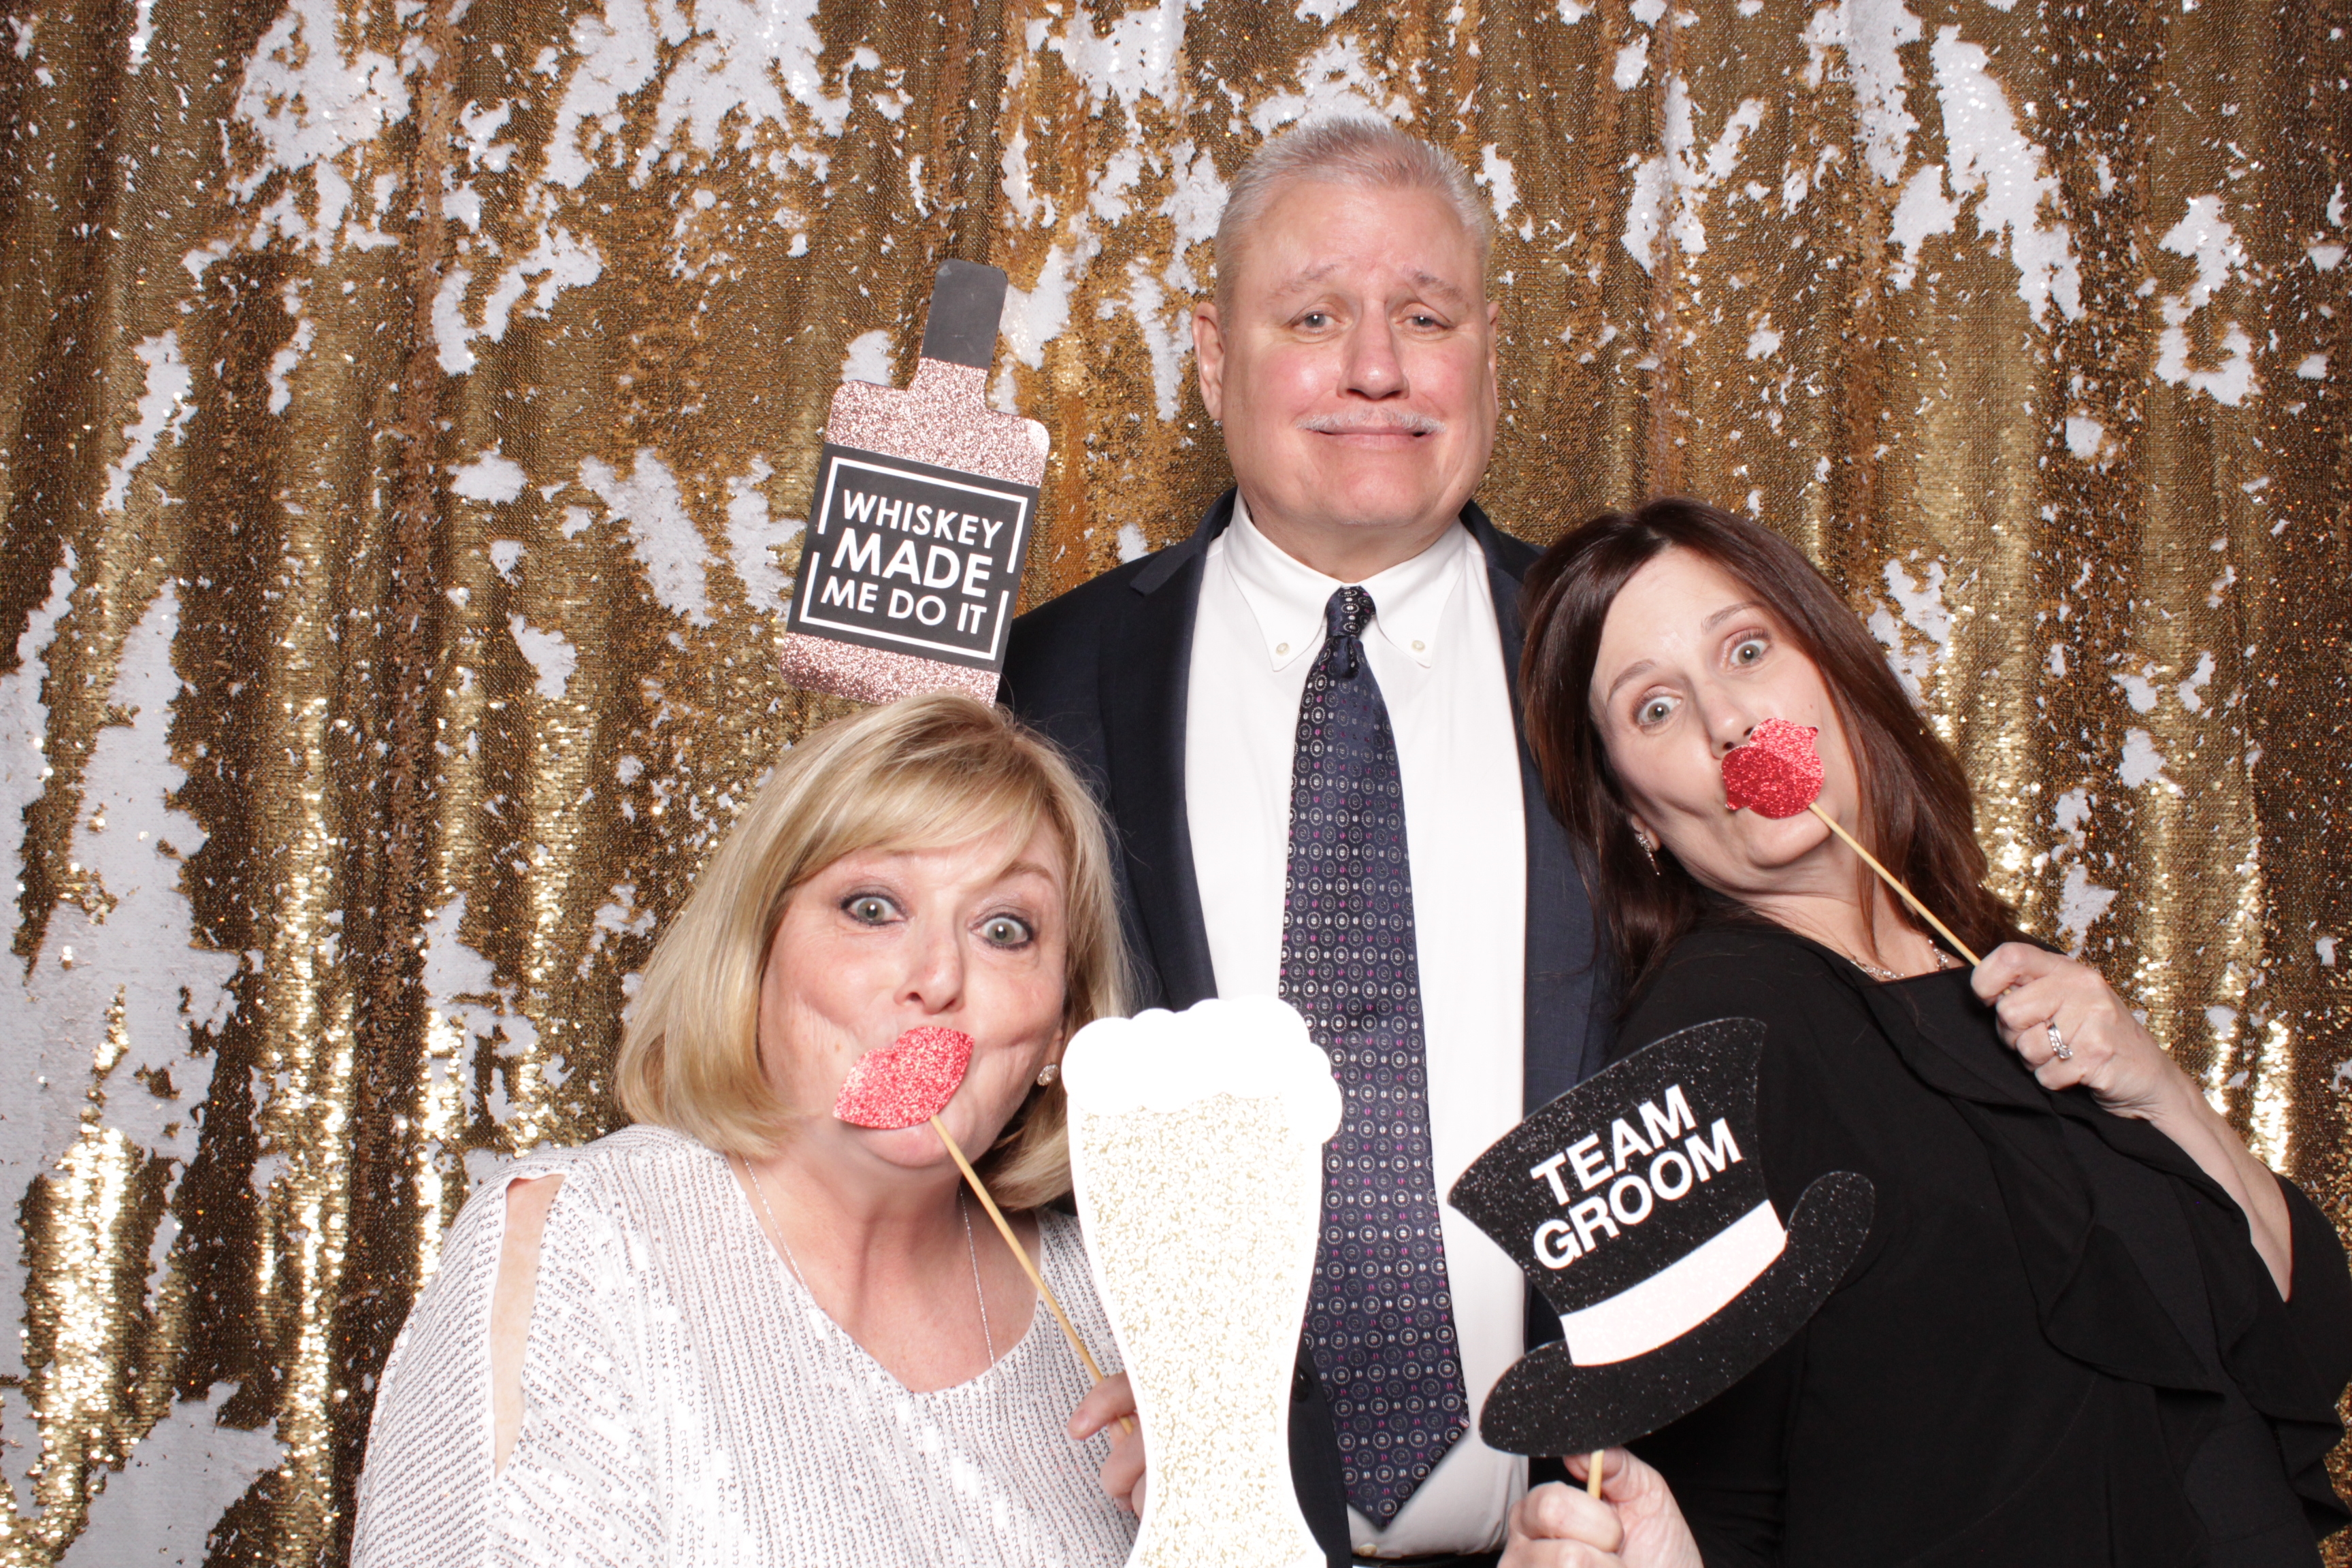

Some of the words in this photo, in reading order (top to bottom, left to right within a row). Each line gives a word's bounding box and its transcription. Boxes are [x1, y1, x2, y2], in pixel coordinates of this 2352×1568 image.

[844, 489, 1004, 549] WHISKEY
[831, 527, 993, 598] MADE
[820, 575, 879, 614] ME
[887, 588, 947, 626] DO
[957, 602, 987, 635] IT
[1530, 1084, 1697, 1206] TEAM
[1533, 1117, 1743, 1269] GROOM
